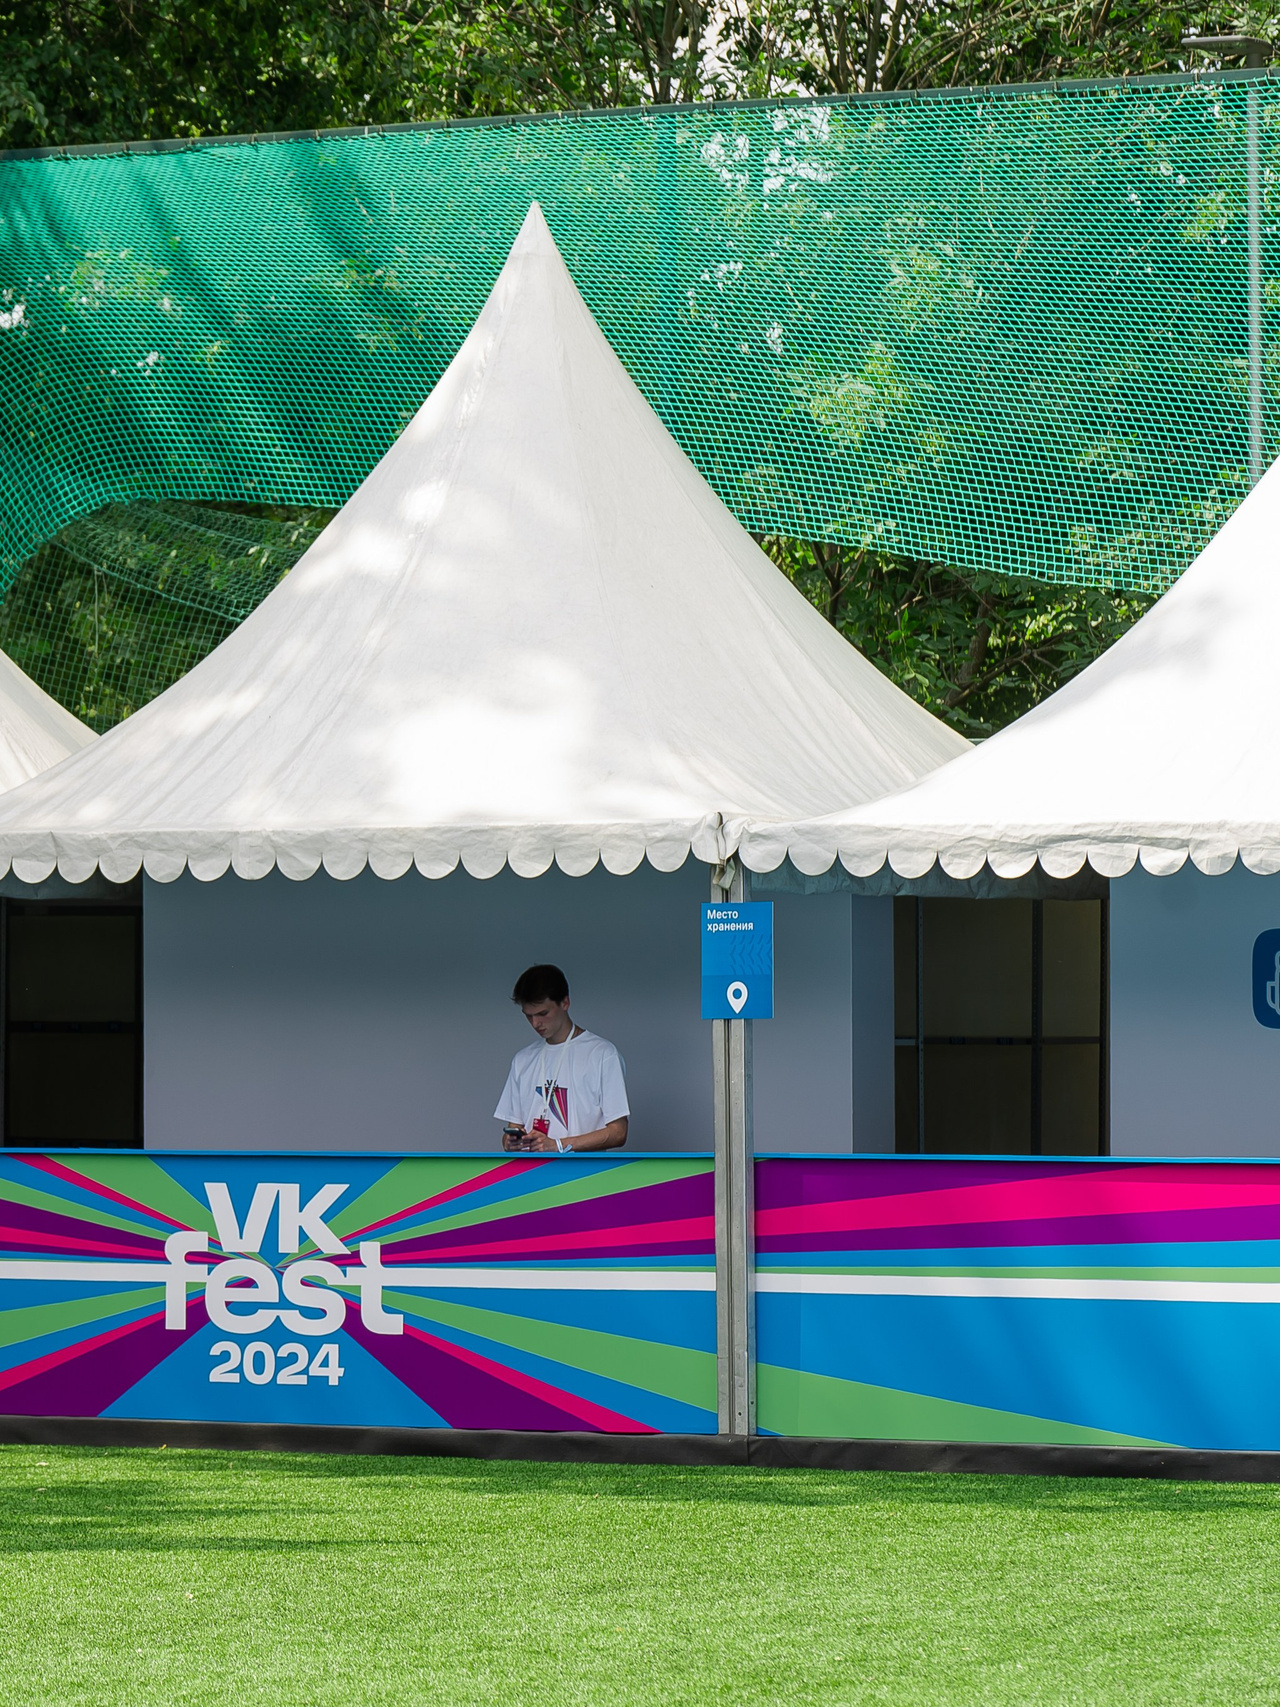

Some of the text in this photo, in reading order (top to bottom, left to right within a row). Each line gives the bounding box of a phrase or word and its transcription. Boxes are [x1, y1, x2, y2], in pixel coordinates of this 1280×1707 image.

[707, 909, 739, 920] Место
[707, 922, 754, 933] хранения
[203, 1181, 352, 1255] VK
[164, 1230, 404, 1336] fest
[209, 1340, 345, 1386] 2024
